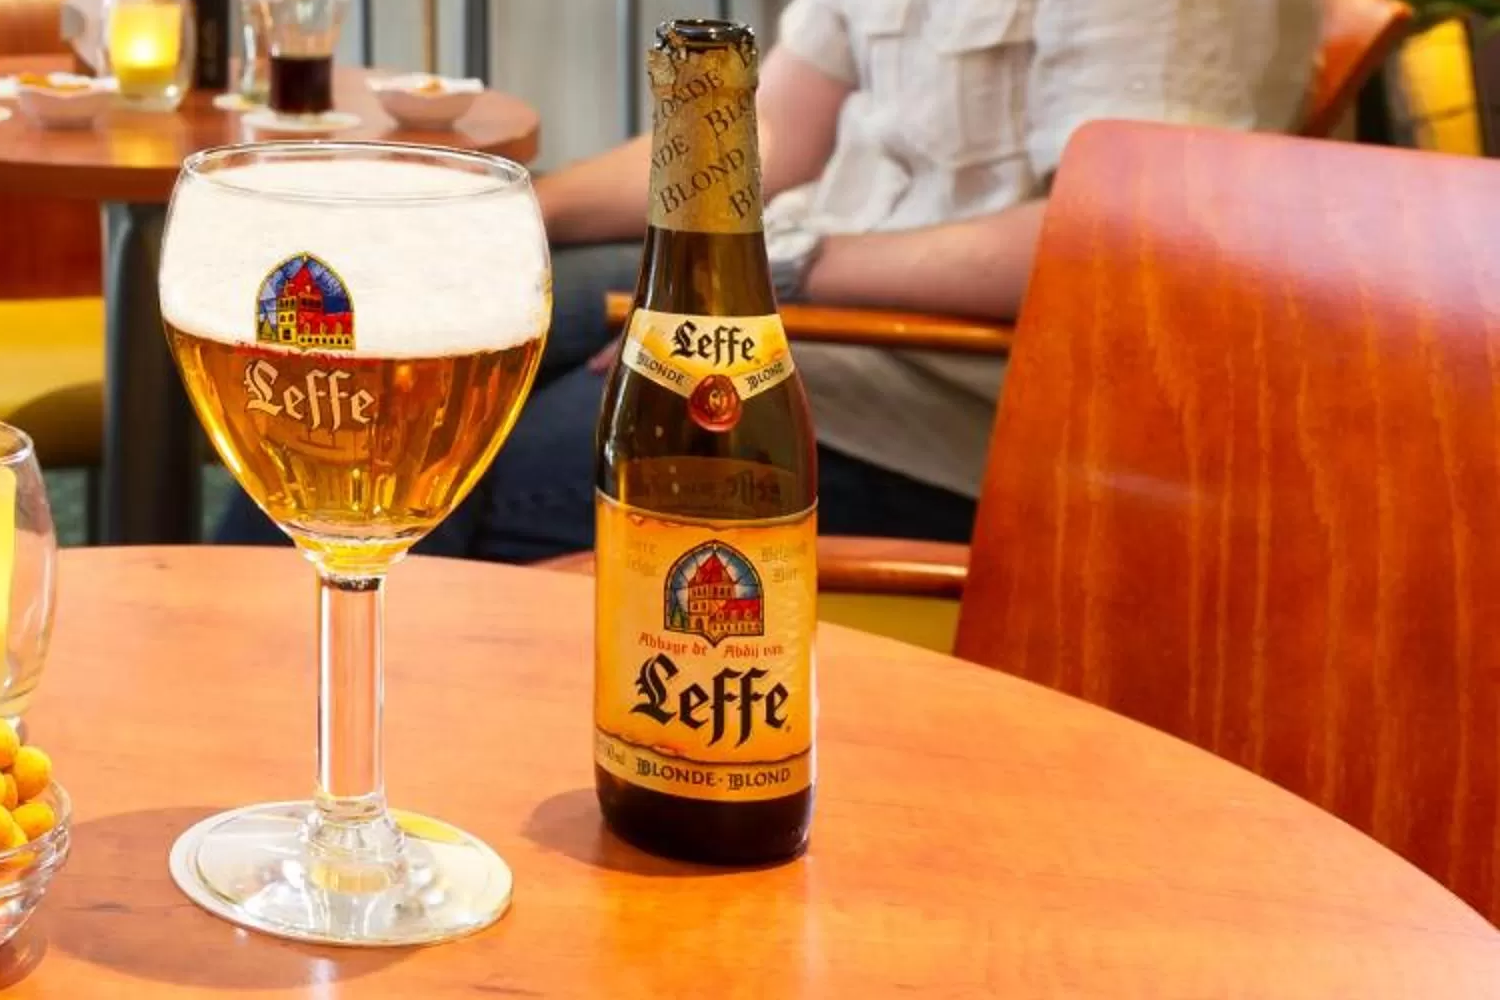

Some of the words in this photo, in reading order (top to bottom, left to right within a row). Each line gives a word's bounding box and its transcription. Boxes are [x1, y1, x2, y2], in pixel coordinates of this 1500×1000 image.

[659, 147, 745, 214] BLOND
[670, 320, 756, 367] Leffe
[636, 351, 686, 387] BLONDE
[745, 362, 785, 392] BLOND
[244, 359, 375, 431] Leffe
[638, 632, 686, 656] Abbaye
[692, 642, 708, 656] de
[723, 644, 759, 659] Abdij
[630, 652, 790, 748] Leffe
[636, 756, 716, 787] BLONDE
[728, 767, 791, 791] BLOND
